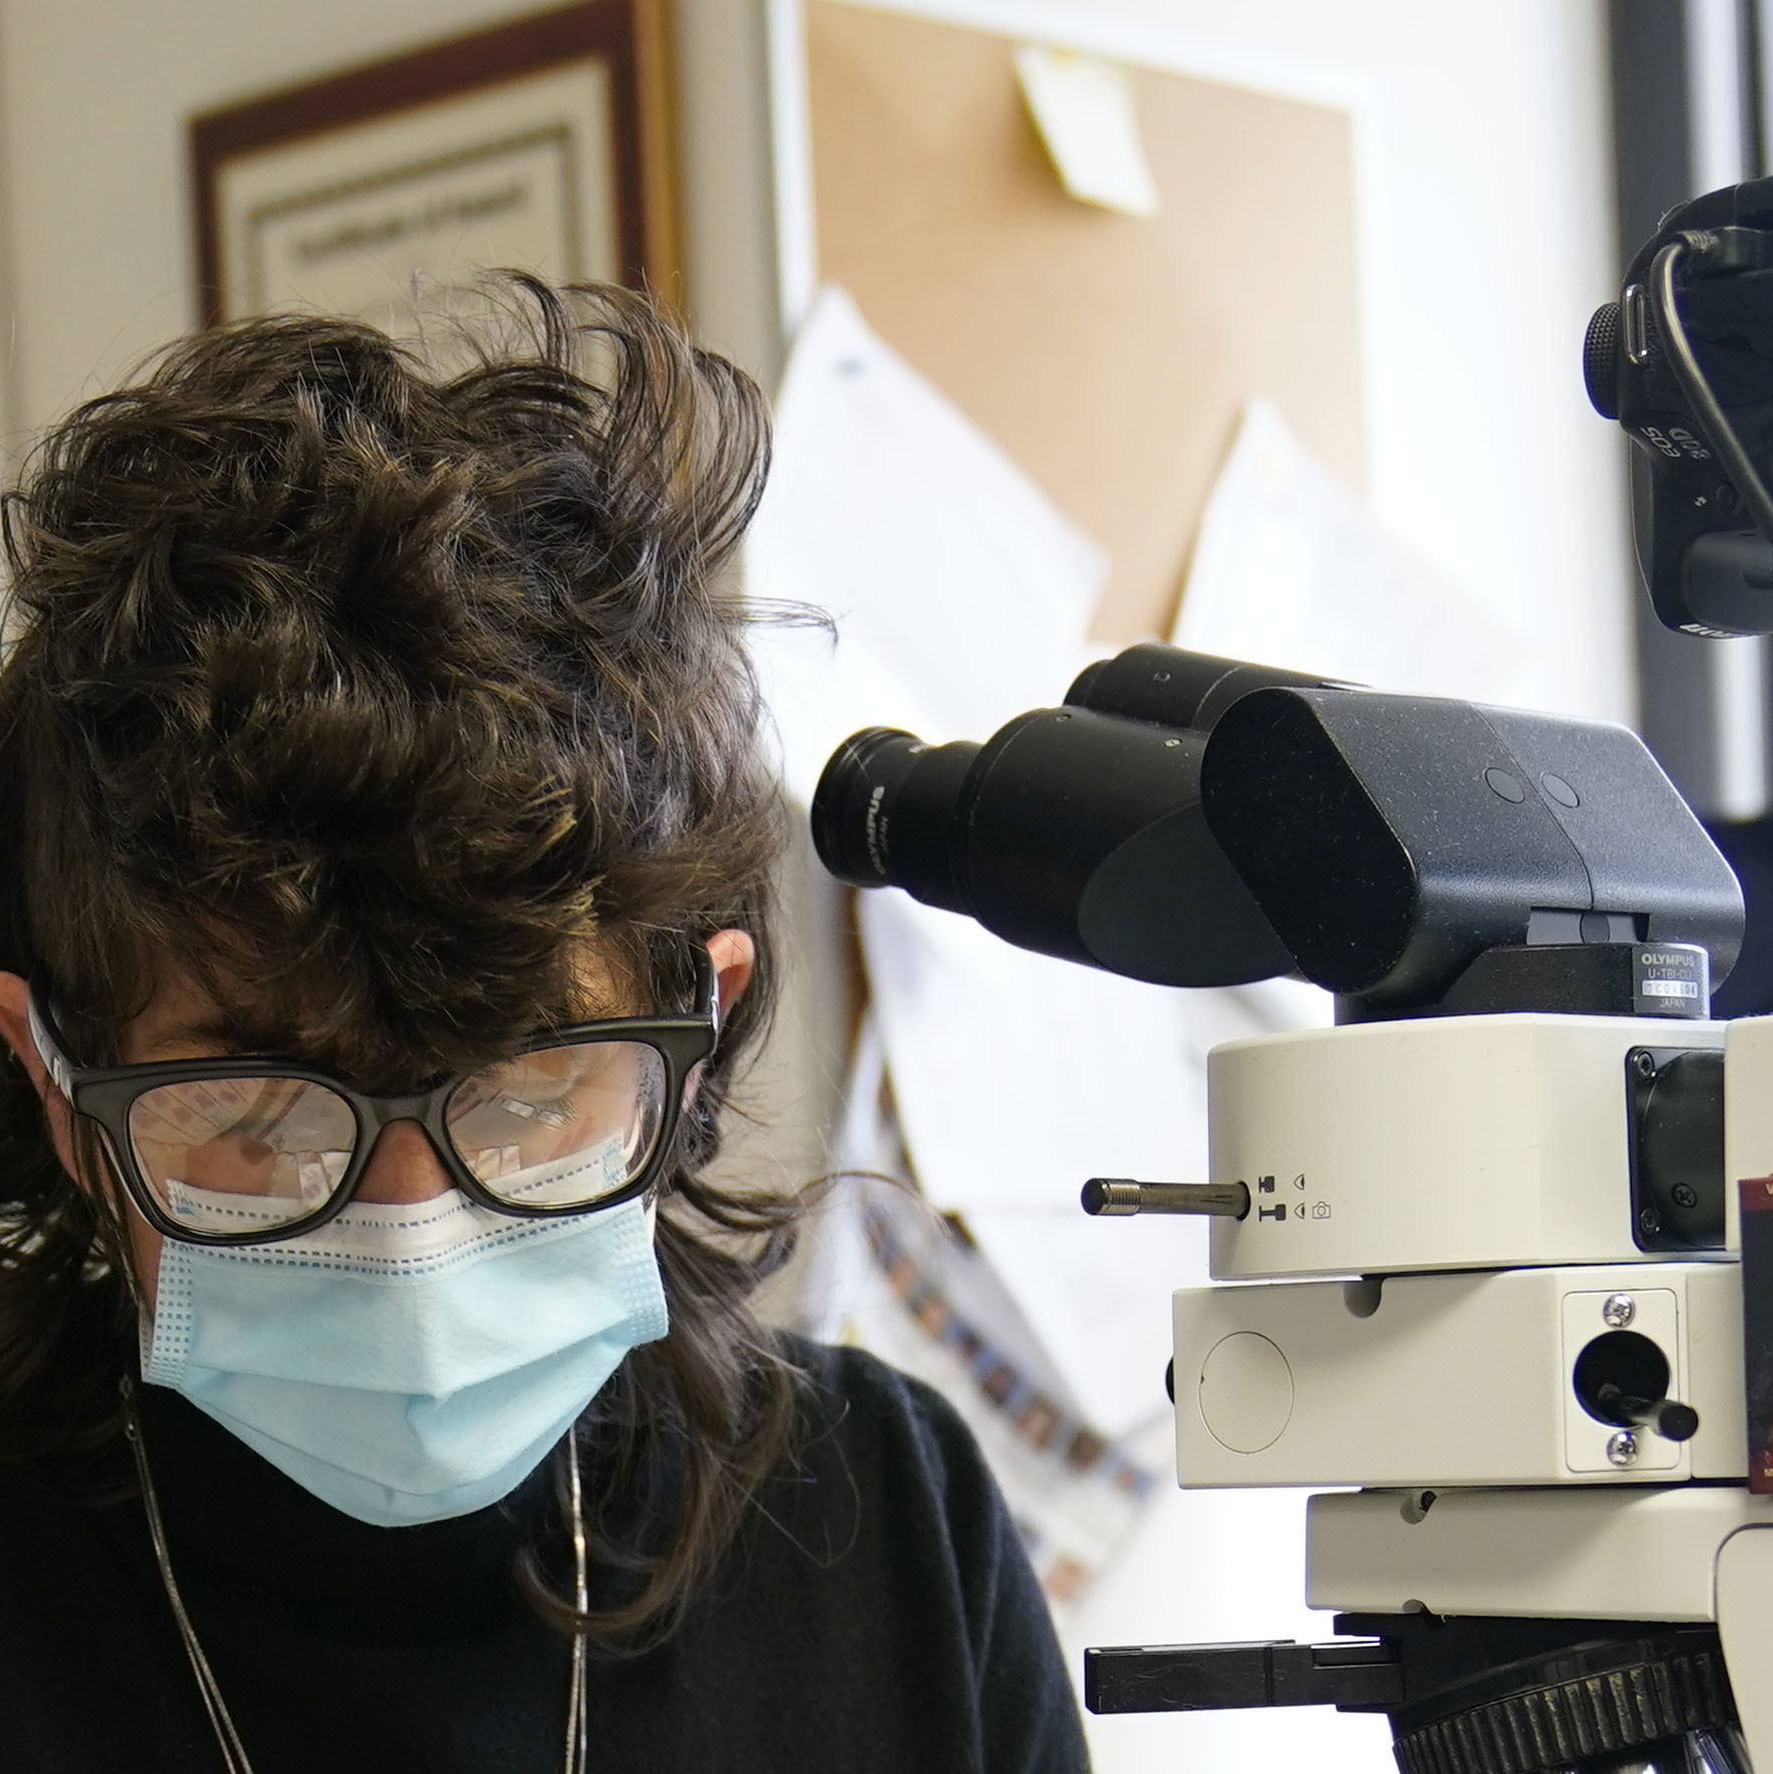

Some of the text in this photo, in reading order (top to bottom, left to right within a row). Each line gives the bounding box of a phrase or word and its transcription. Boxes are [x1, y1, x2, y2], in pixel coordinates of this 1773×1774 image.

[1640, 426, 1681, 458] EOS
[1641, 953, 1695, 967] OLYMPUS
[1659, 998, 1686, 1008] JAPAN
